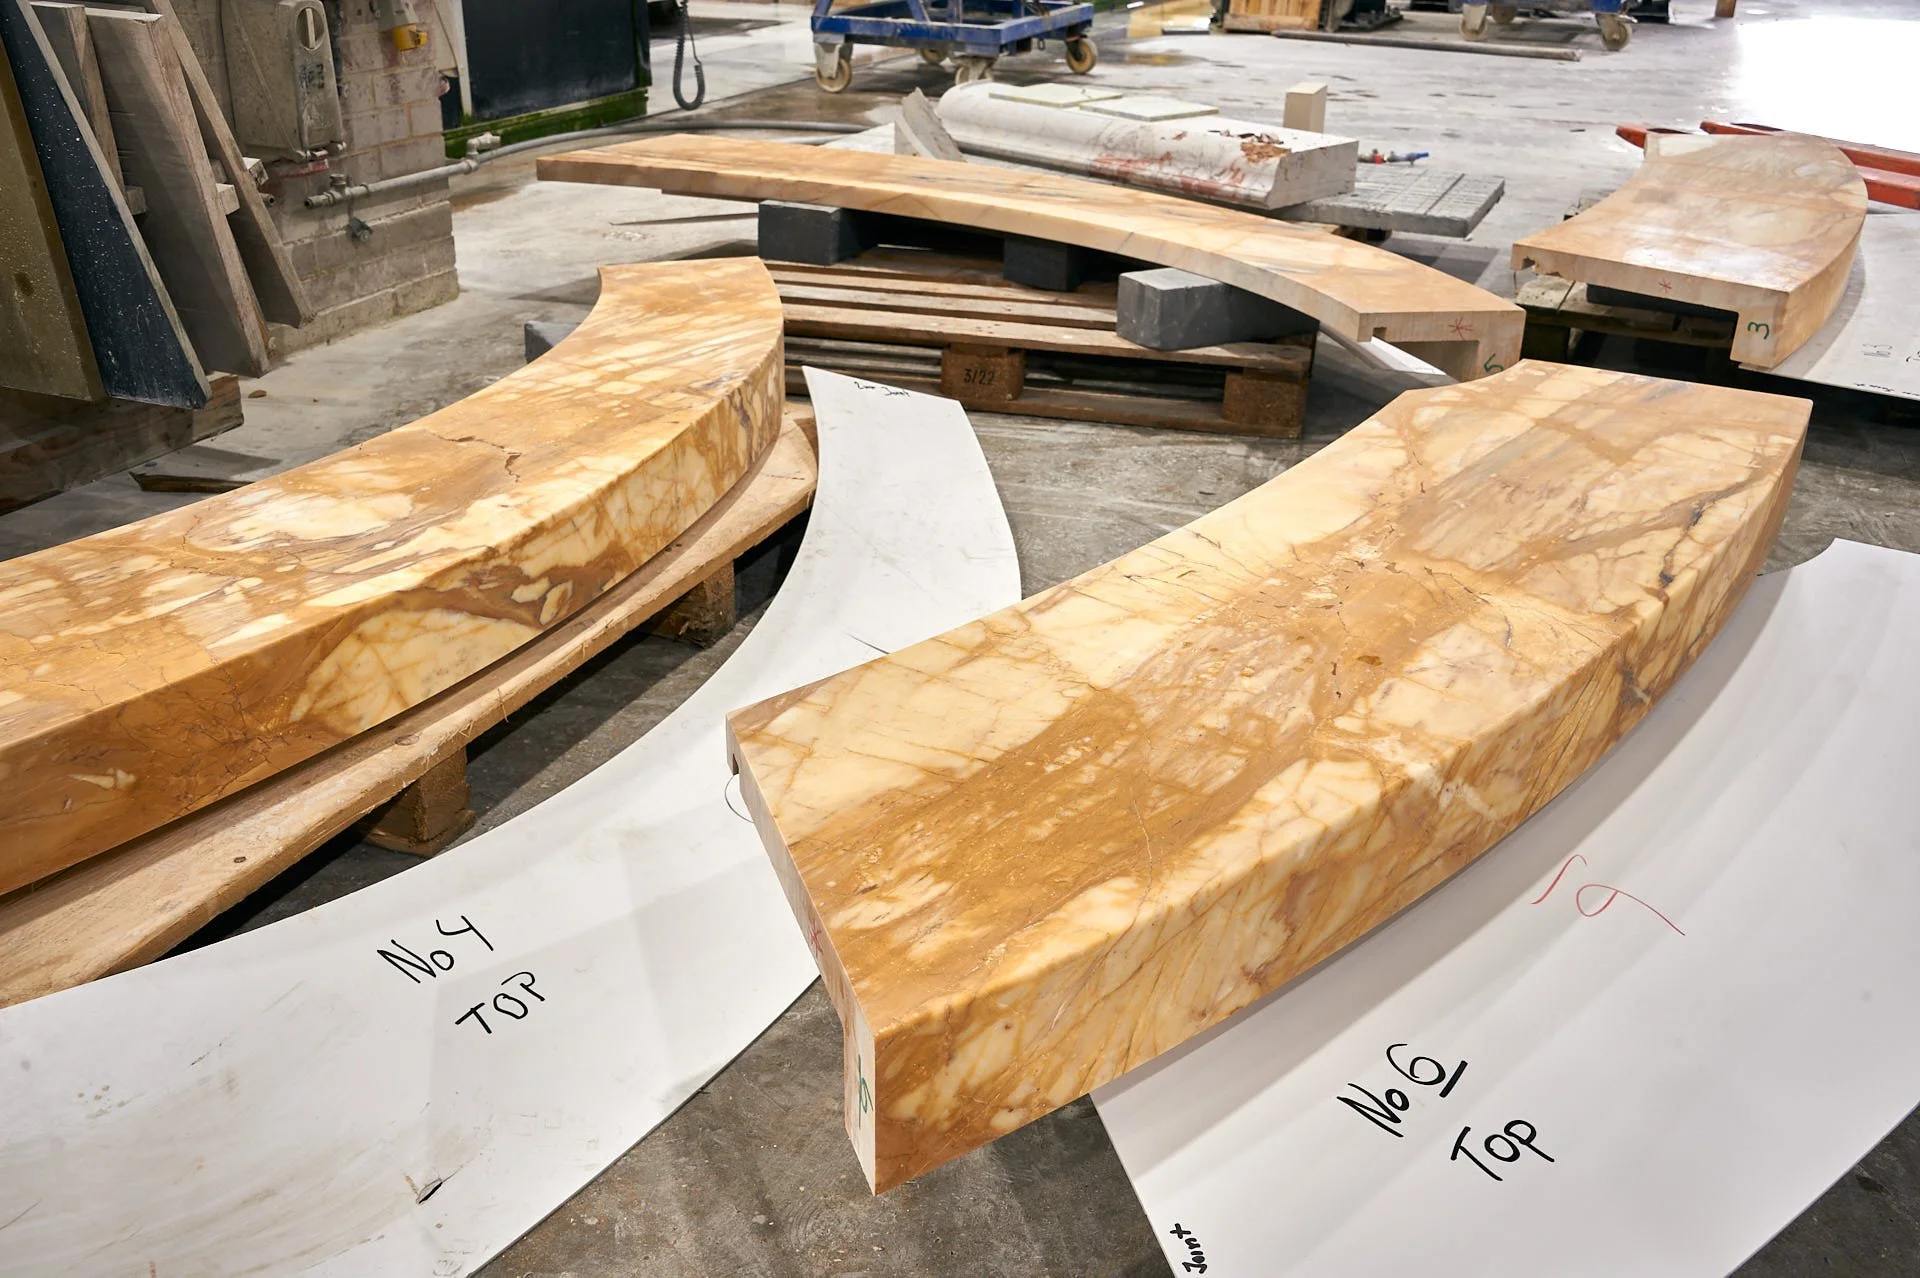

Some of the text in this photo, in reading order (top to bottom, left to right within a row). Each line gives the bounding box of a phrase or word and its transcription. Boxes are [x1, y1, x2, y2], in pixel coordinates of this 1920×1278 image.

[1747, 321, 1770, 340] 3
[963, 367, 996, 385] 3/22
[376, 939, 455, 984] No
[454, 971, 546, 1035] TOP
[1336, 1043, 1447, 1138] No 6
